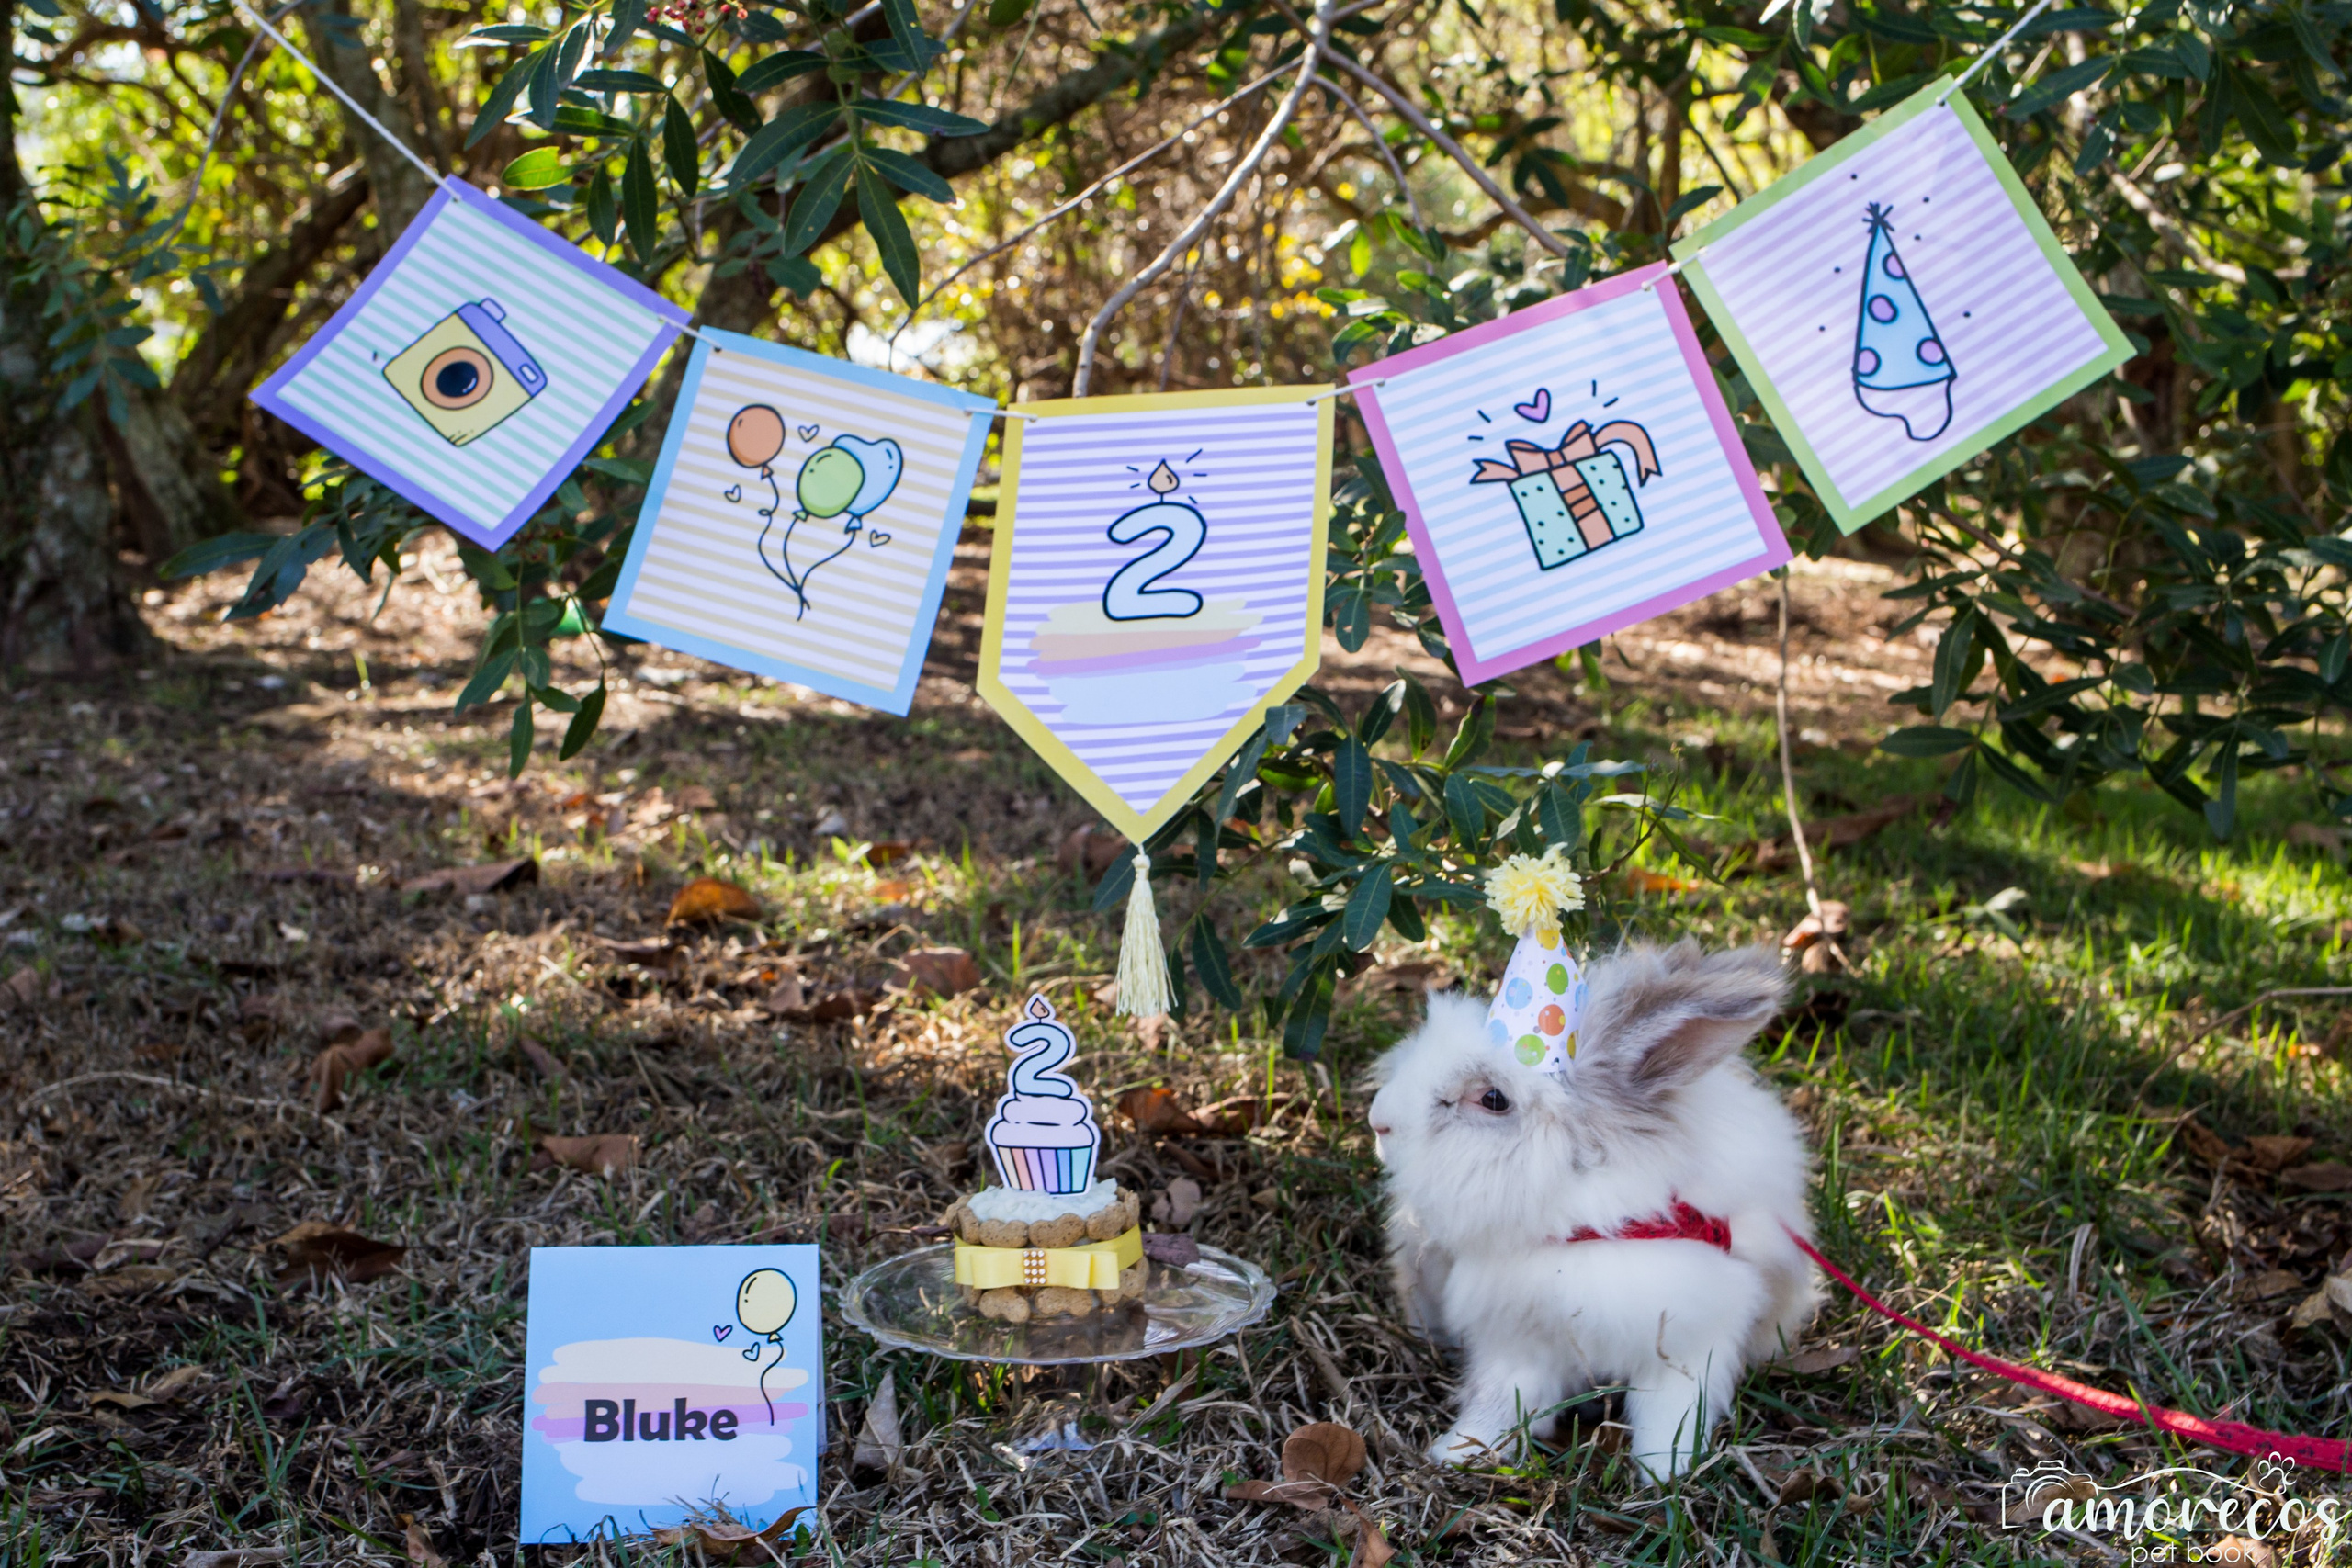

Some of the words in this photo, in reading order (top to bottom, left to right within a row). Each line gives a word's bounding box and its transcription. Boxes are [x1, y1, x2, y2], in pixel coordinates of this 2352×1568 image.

[1102, 502, 1207, 621] 2
[1009, 1022, 1072, 1100] 2
[583, 1396, 740, 1443] Bluke
